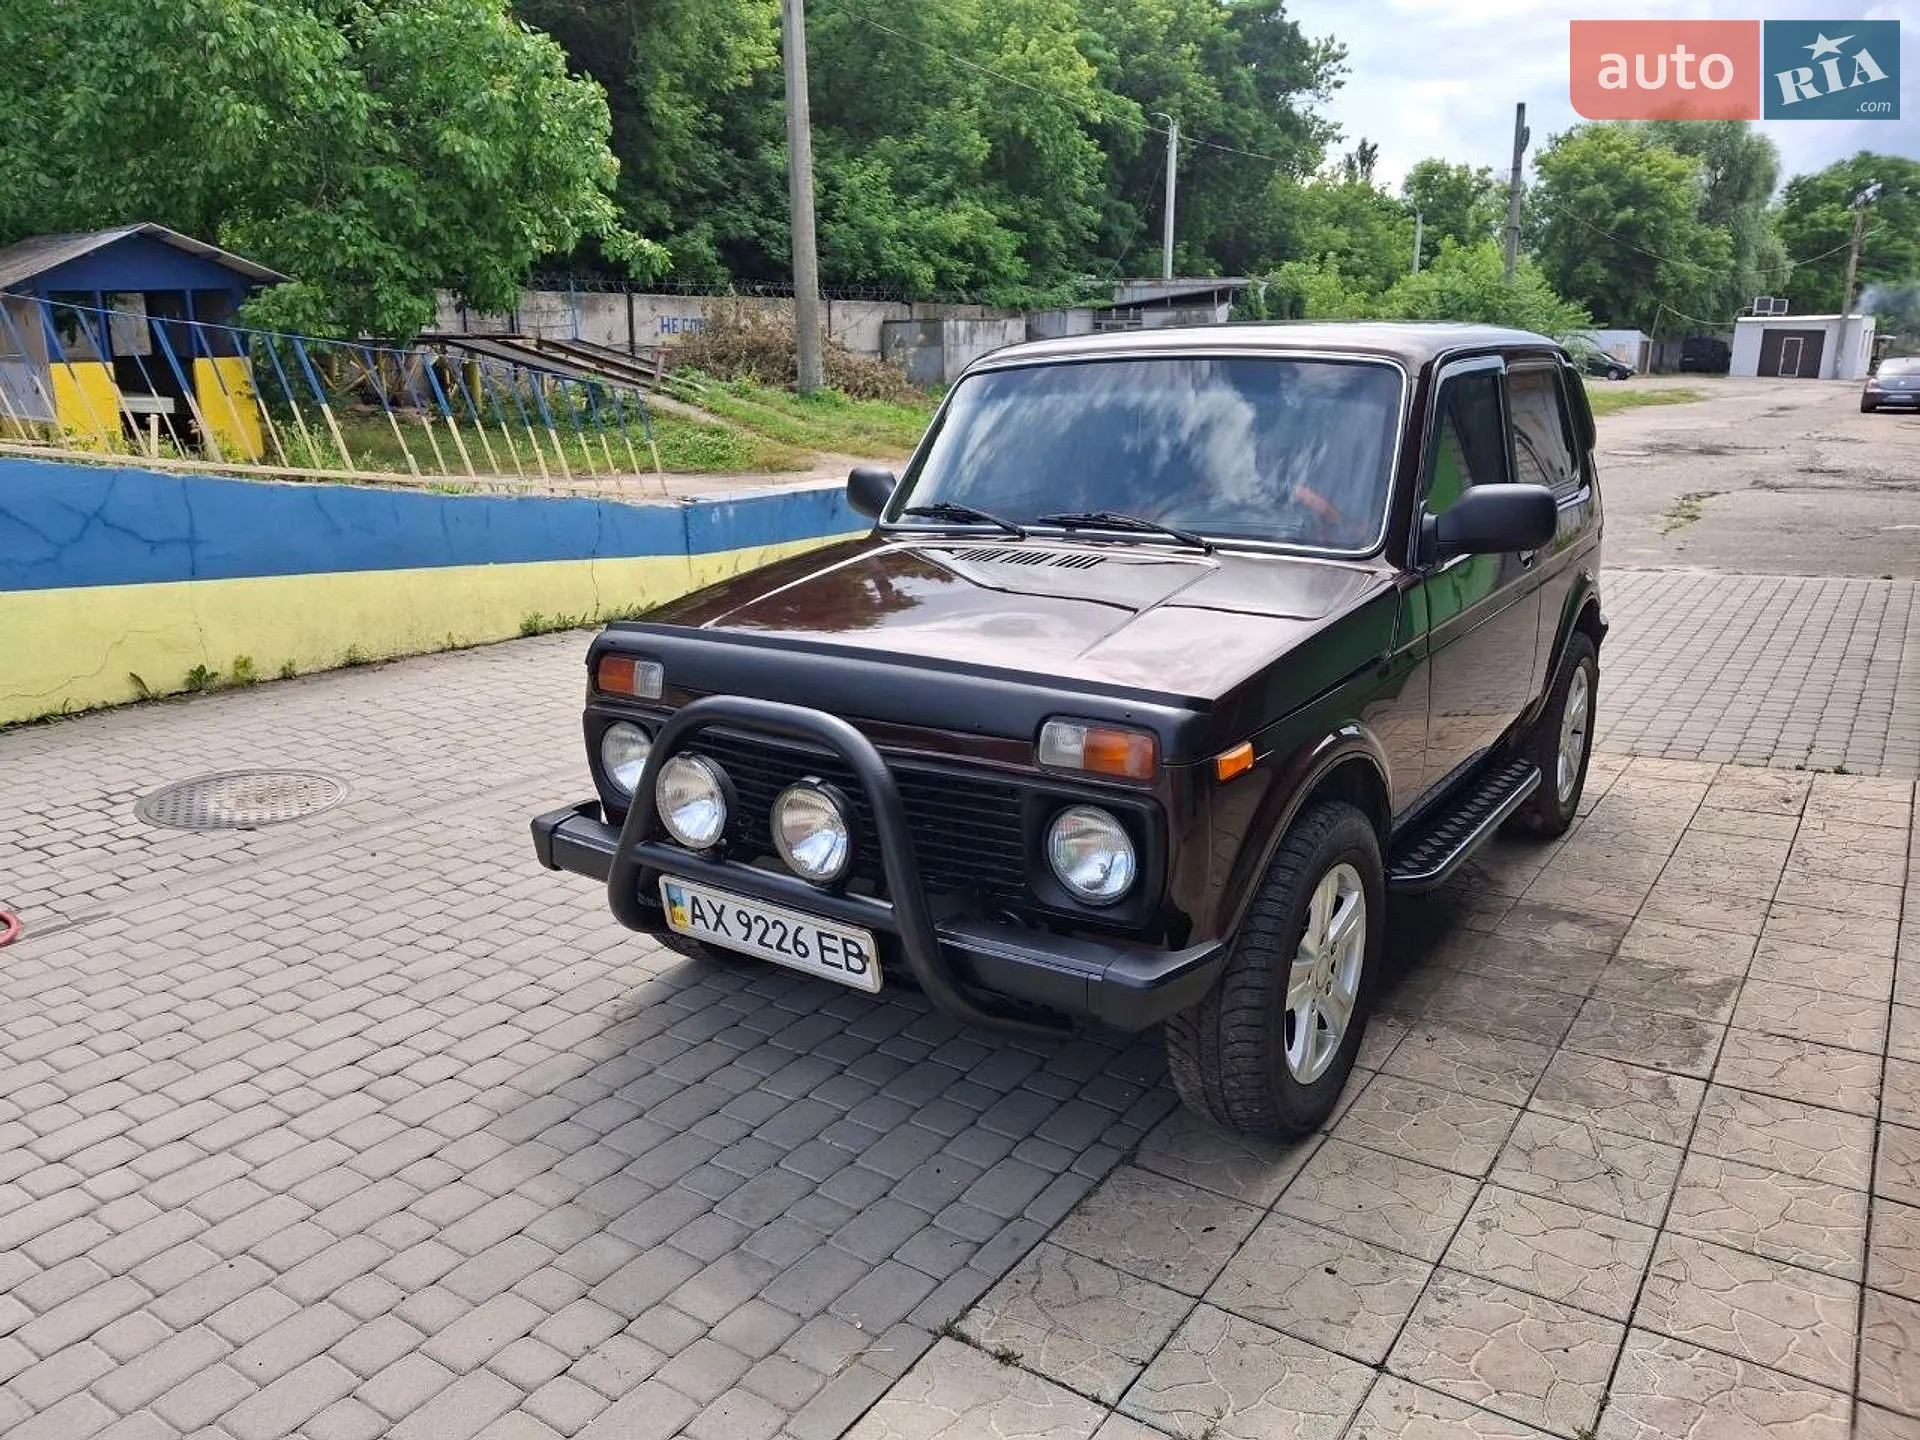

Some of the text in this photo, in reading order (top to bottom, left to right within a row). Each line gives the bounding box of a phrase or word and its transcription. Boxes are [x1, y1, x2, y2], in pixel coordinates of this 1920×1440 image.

[690, 895, 869, 975] AX 9226 EB
